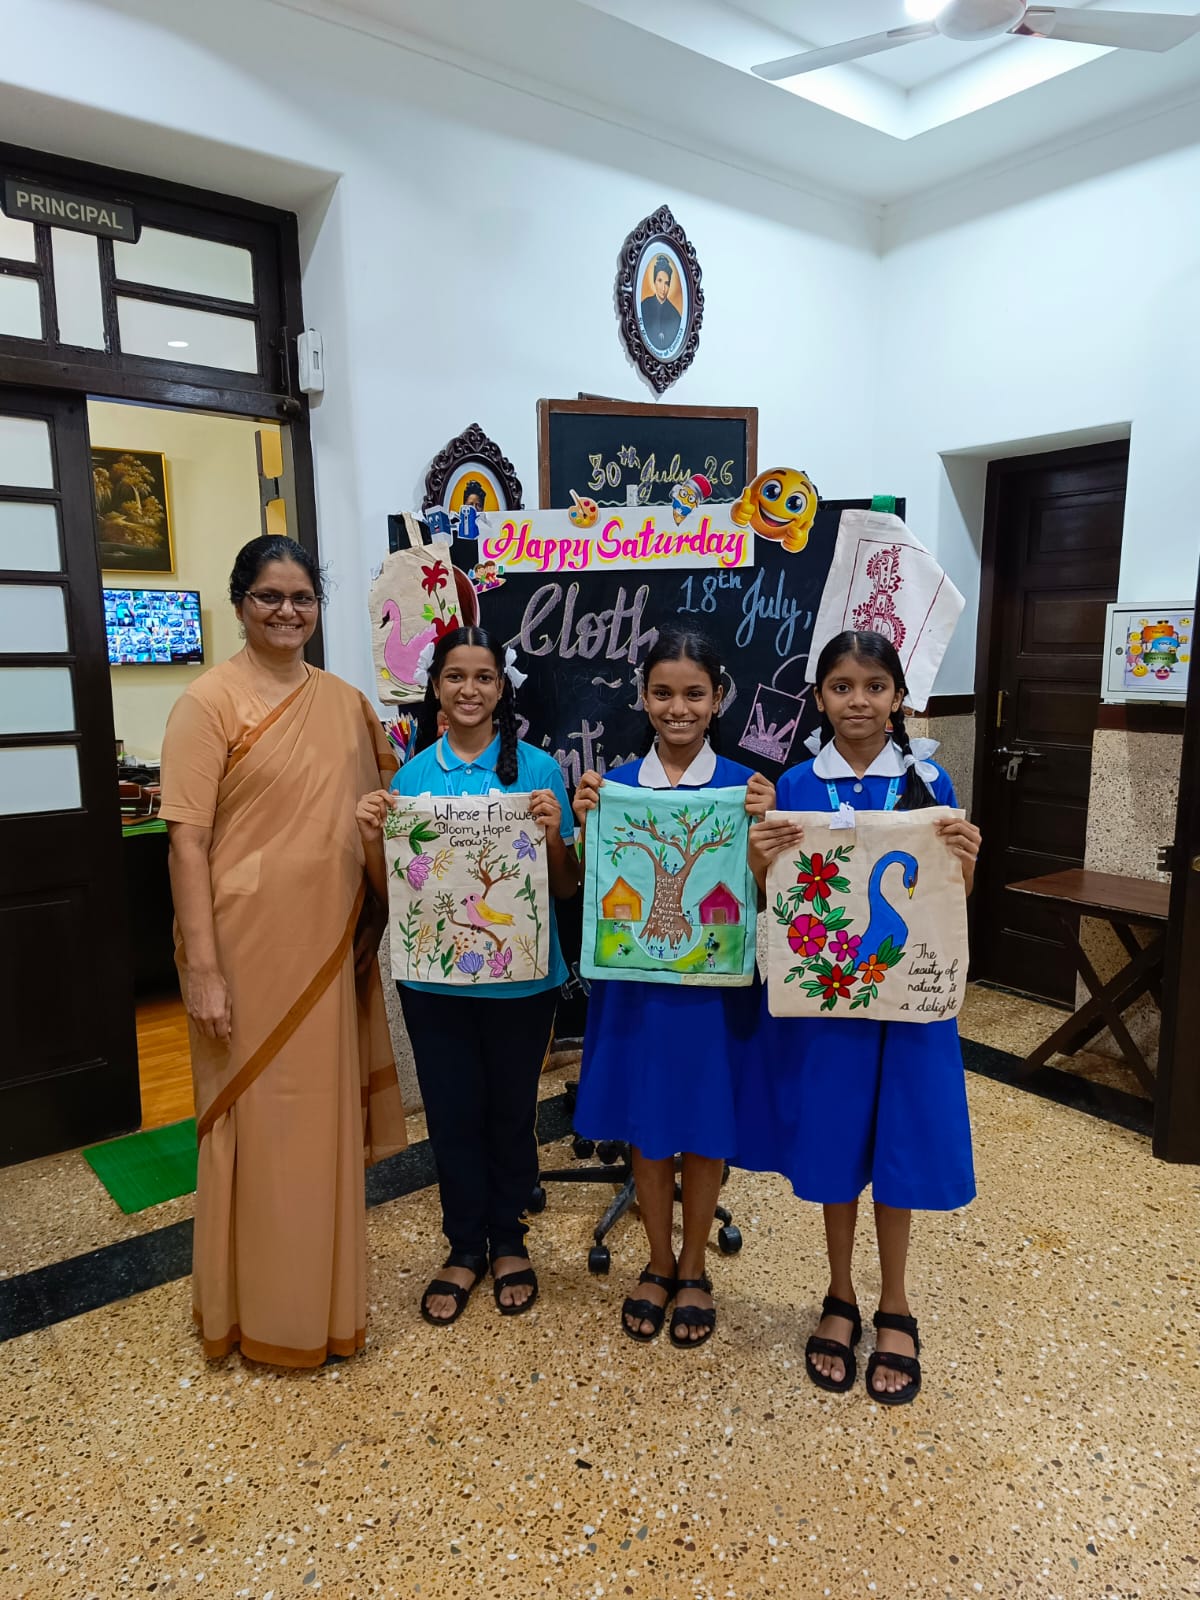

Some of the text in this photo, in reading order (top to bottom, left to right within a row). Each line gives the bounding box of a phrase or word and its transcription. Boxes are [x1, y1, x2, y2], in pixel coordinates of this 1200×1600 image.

[16, 190, 123, 229] PRINCIPAL
[588, 445, 641, 491] 30th
[704, 456, 735, 485] 26
[482, 516, 747, 571] Happy Saturday
[676, 570, 742, 614] 18th
[502, 582, 660, 665] Cloth
[434, 803, 480, 821] Where
[434, 822, 512, 838] Bloom, Hope
[912, 943, 937, 959] The
[945, 959, 958, 981] of
[907, 978, 957, 993] nature is
[915, 997, 957, 1017] delight
